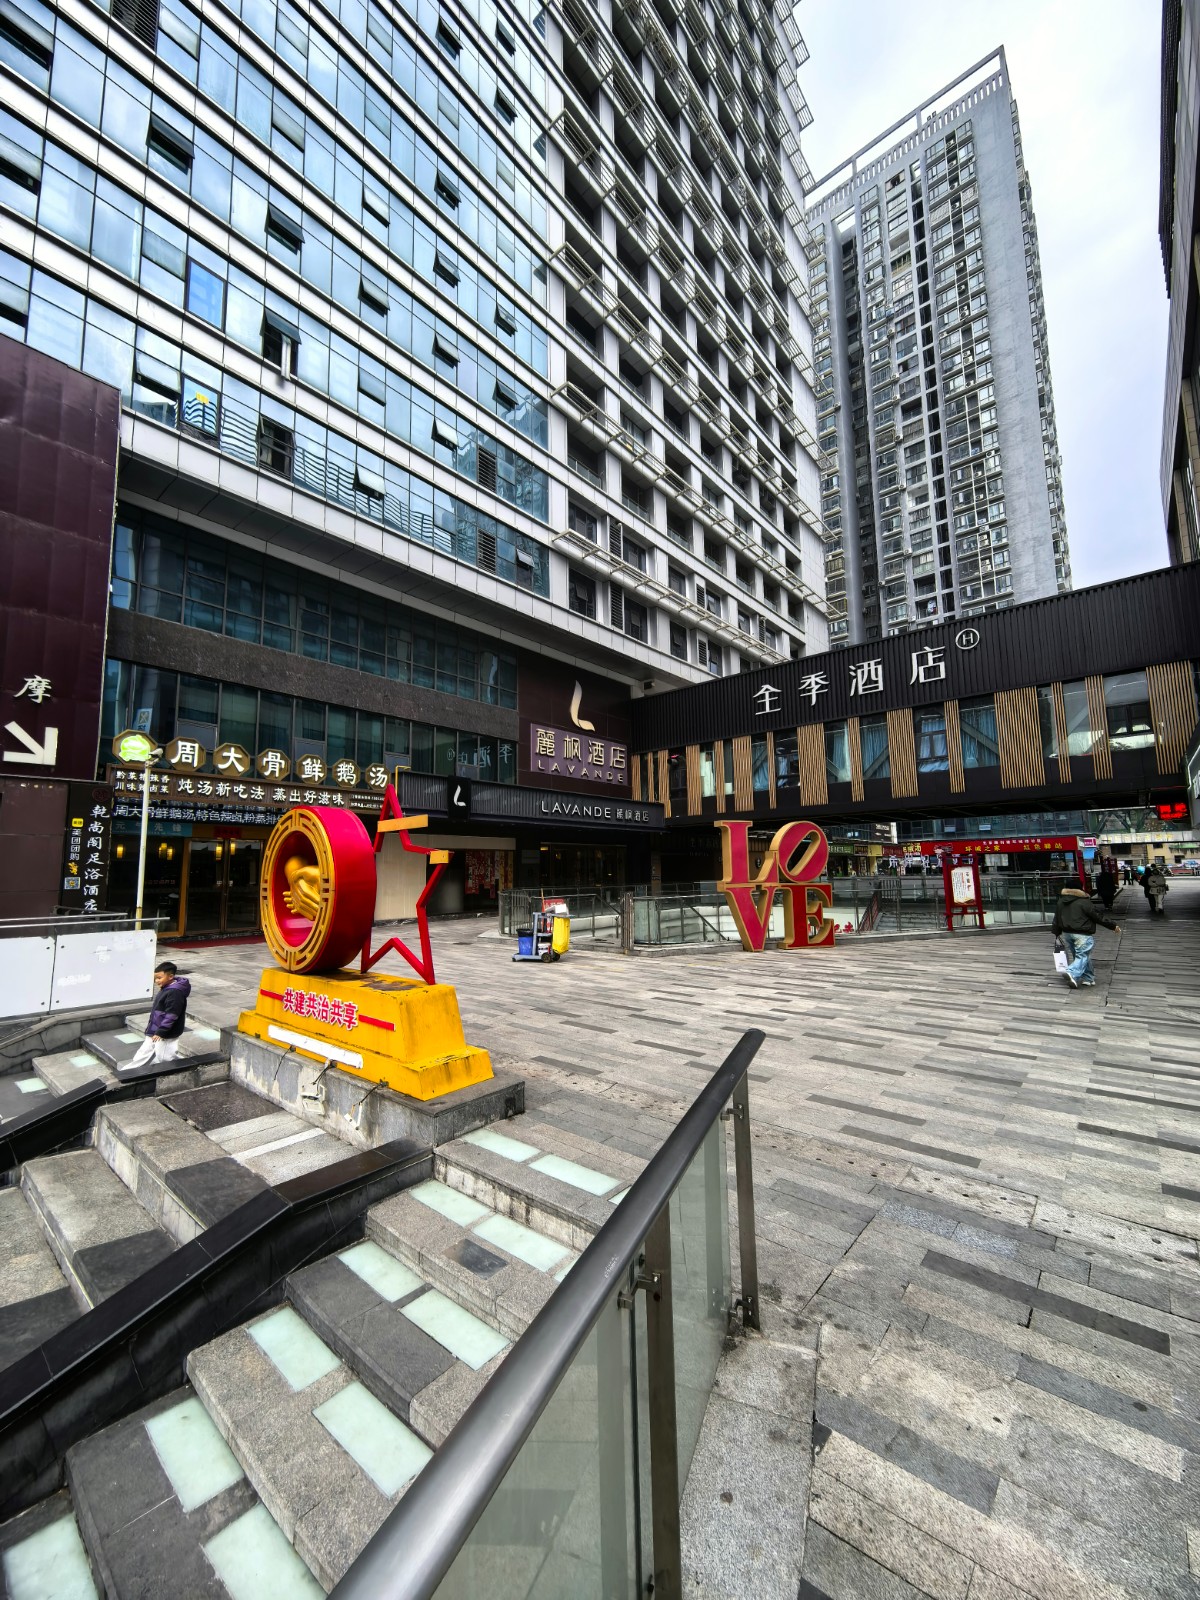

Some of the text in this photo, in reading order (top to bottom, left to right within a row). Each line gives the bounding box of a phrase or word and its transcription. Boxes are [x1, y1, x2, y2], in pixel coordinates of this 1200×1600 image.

[14, 675, 52, 704] 摩
[752, 646, 946, 716] 全季酒店
[170, 740, 389, 788] 周大骨鲜鹅汤
[538, 759, 624, 782] LAVANDE
[177, 779, 265, 800] 炖汤新吃法
[272, 788, 345, 806] 蒸出好滋味
[541, 800, 612, 819] LAVANDE
[283, 987, 359, 1030] 共建共治共享
